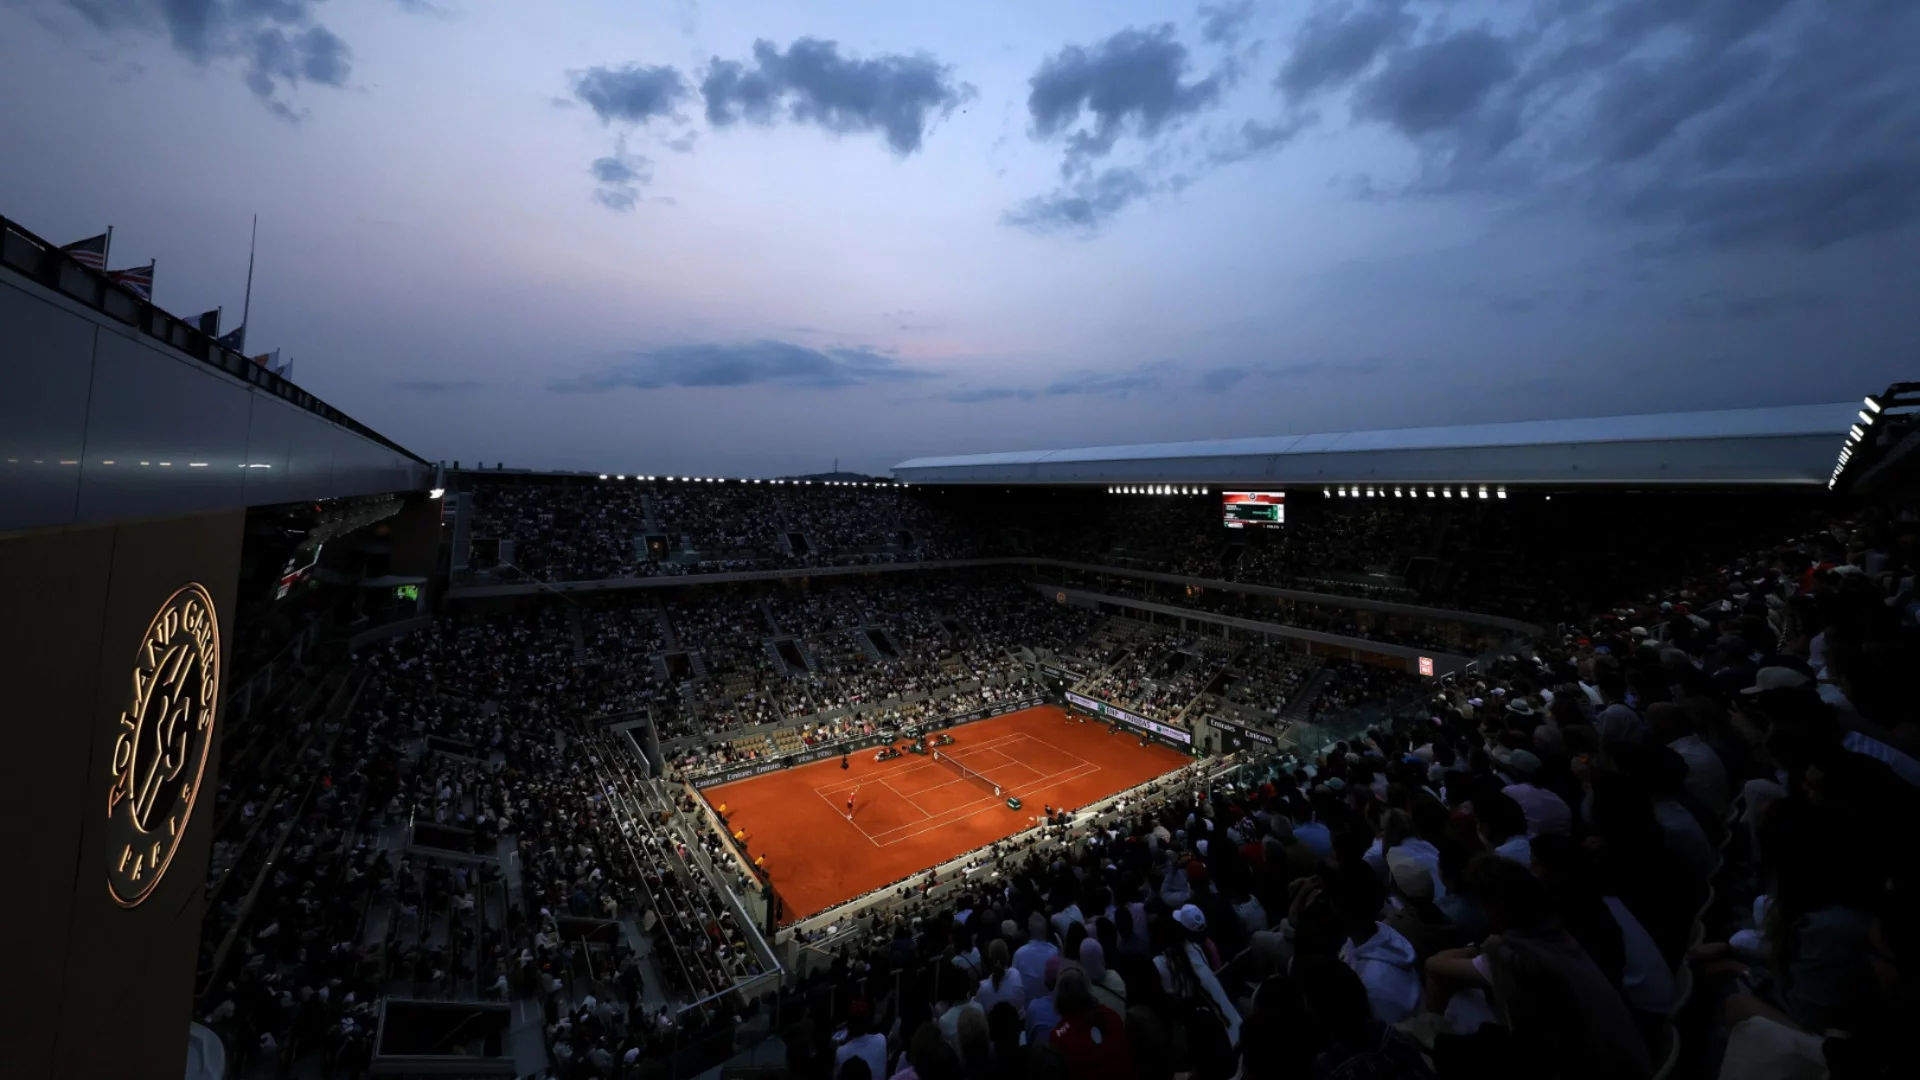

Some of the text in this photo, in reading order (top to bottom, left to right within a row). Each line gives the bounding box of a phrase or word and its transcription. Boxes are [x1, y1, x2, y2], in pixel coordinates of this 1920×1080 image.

[108, 600, 214, 818] ROLAND GARROS
[1210, 718, 1236, 733] Emirates
[1244, 730, 1273, 744] Emirates
[695, 762, 781, 788] Emirates Emirates Emirates
